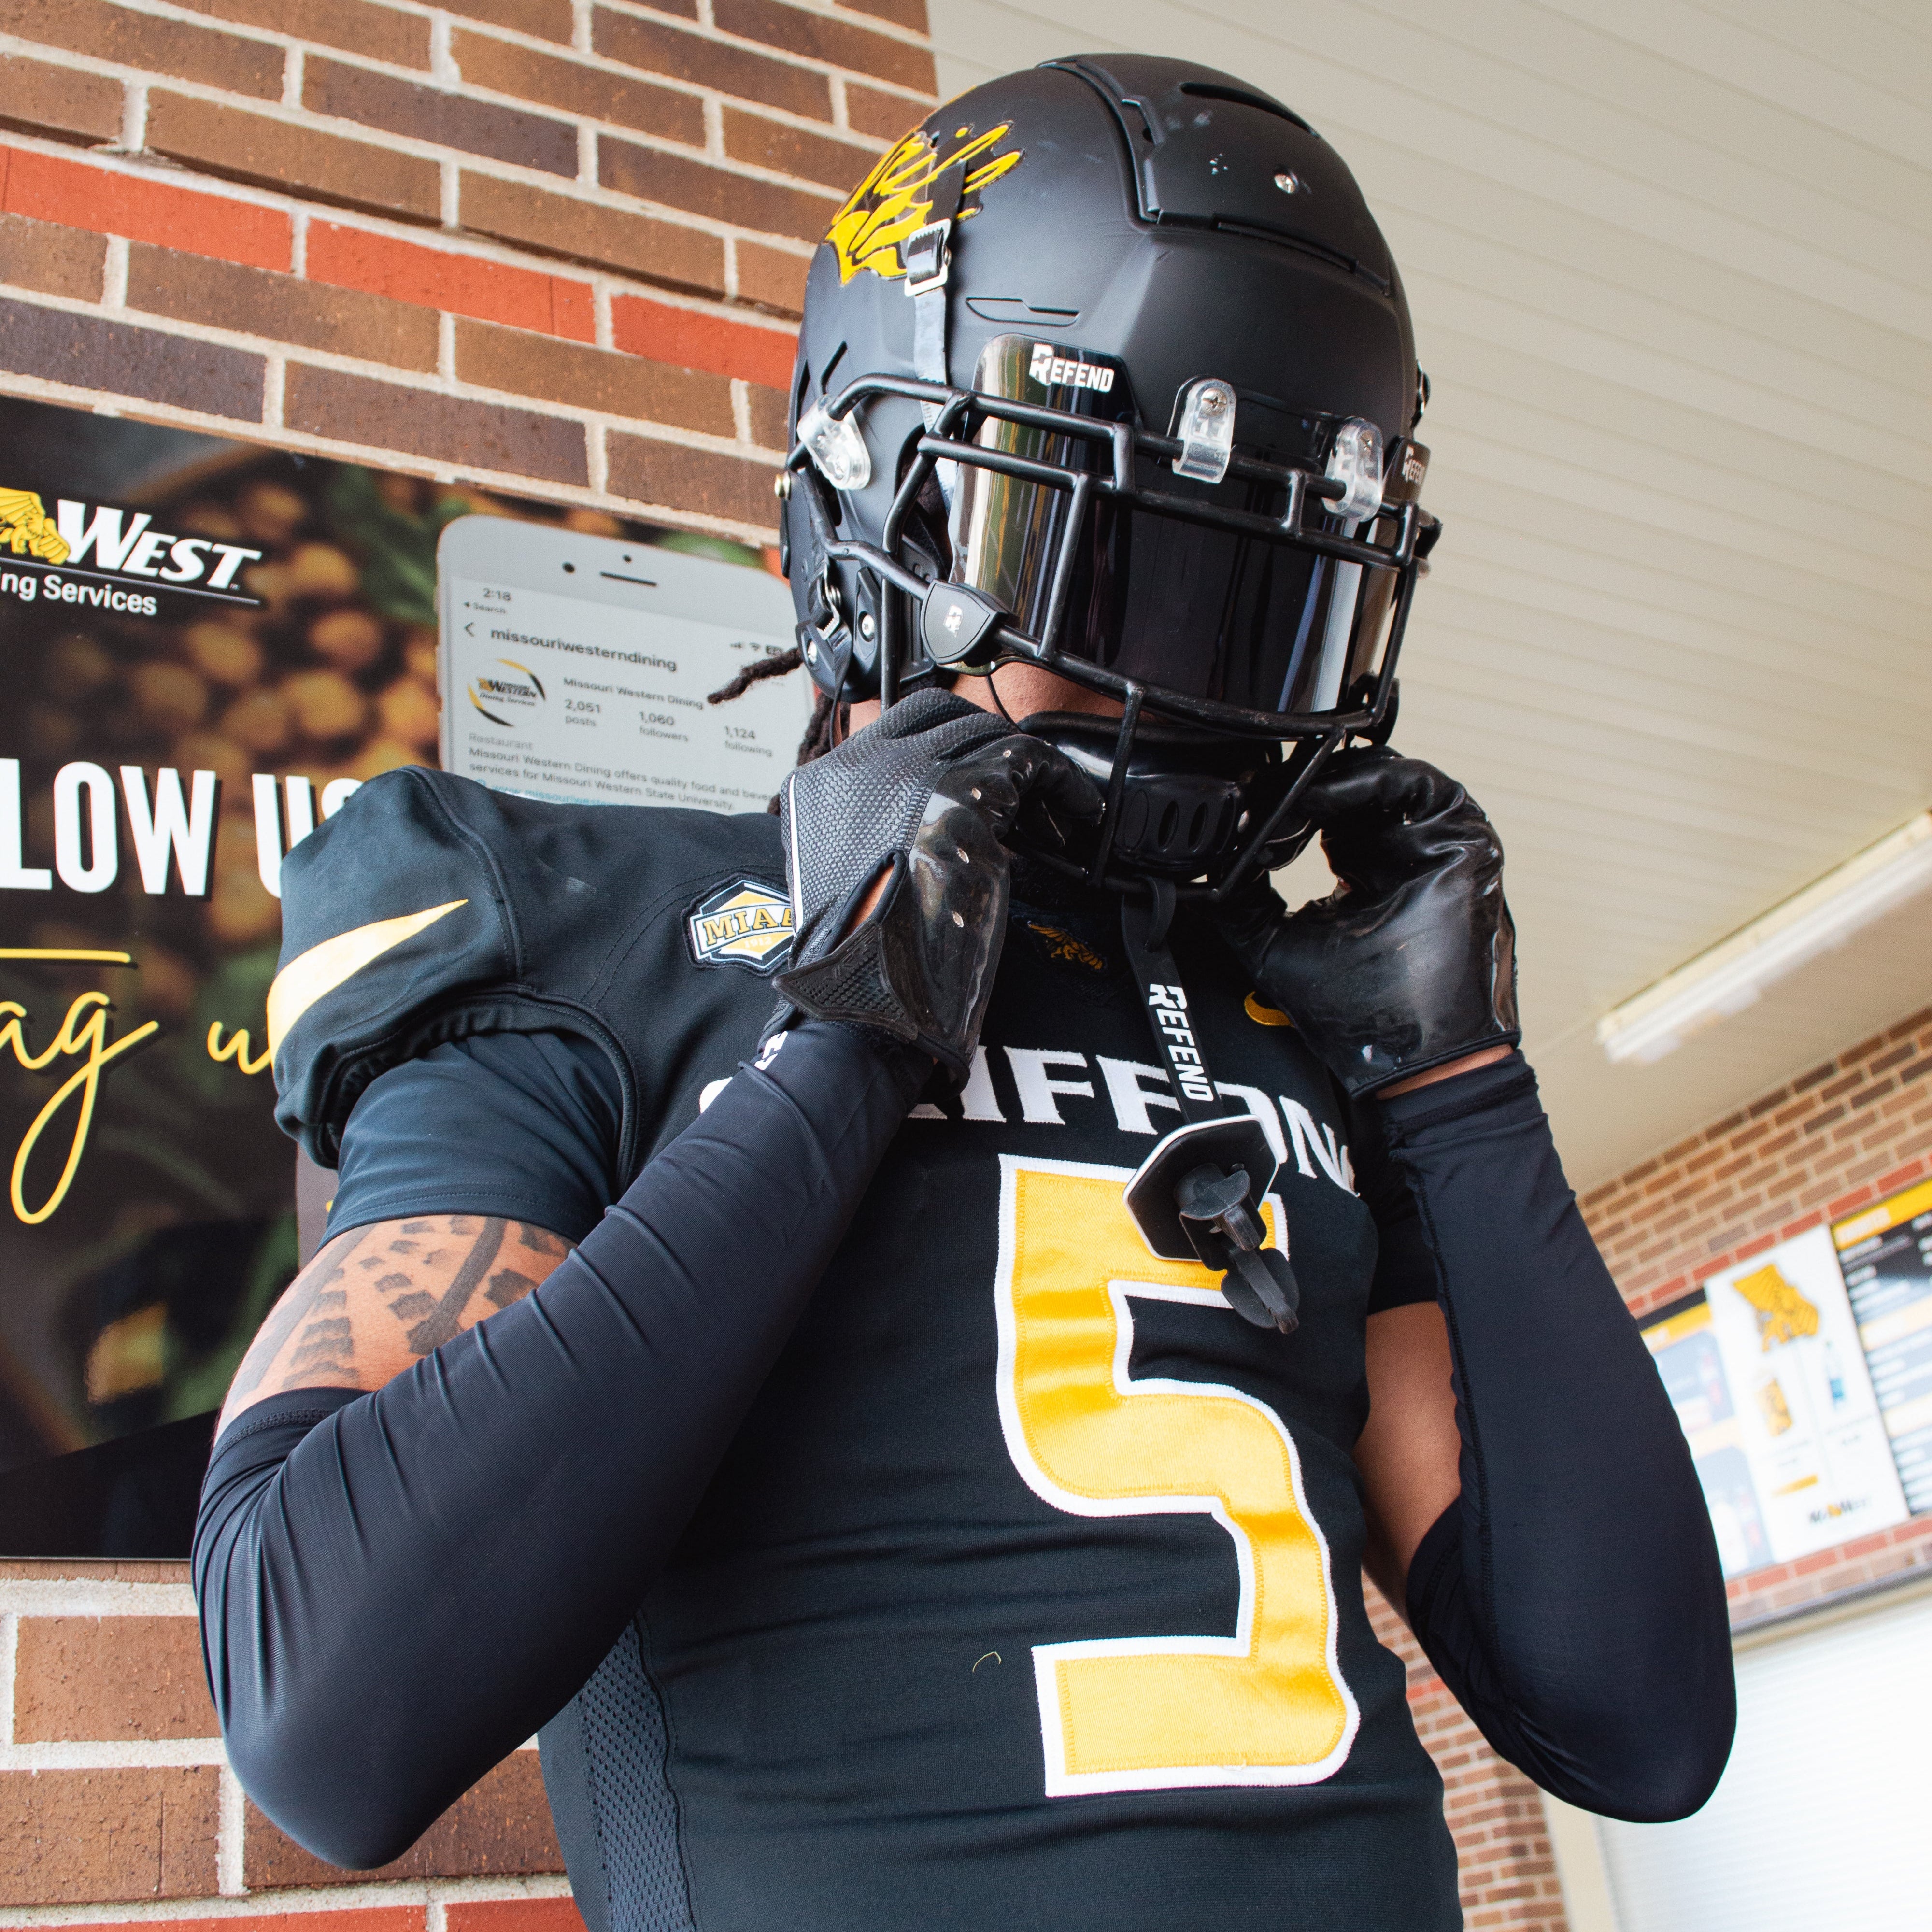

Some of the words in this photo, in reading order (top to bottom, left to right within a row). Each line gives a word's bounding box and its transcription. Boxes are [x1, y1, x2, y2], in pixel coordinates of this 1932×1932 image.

[1029, 343, 1114, 393] REFEND
[57, 499, 262, 590] WEST
[0, 566, 37, 602] ng
[43, 574, 157, 616] Services
[483, 588, 512, 602] 2:18
[490, 628, 677, 672] missouriwesterndining
[563, 677, 613, 693] Missouri
[616, 686, 665, 702] Western
[668, 694, 704, 710] Dining
[469, 732, 533, 751] Restaurant
[565, 715, 597, 727] posts
[639, 726, 689, 742] followers
[725, 740, 772, 758] following
[639, 711, 675, 725] 1,060
[725, 725, 756, 740] 1,124
[469, 747, 520, 763] Missouri
[523, 755, 572, 771] Western
[574, 762, 611, 778] Dining
[614, 769, 647, 782] offers
[650, 774, 688, 790] quality
[691, 780, 716, 793] food
[719, 786, 739, 797] and
[469, 763, 519, 778] services
[522, 769, 539, 780] for
[541, 772, 592, 788] Missouri
[594, 780, 642, 795] Western
[645, 787, 675, 800] State
[0, 758, 216, 896] LOW
[252, 773, 366, 899] U
[744, 936, 773, 949] 1912
[1149, 983, 1214, 1102] REFEND
[0, 991, 158, 1224] ag
[995, 1153, 1361, 1798] 5
